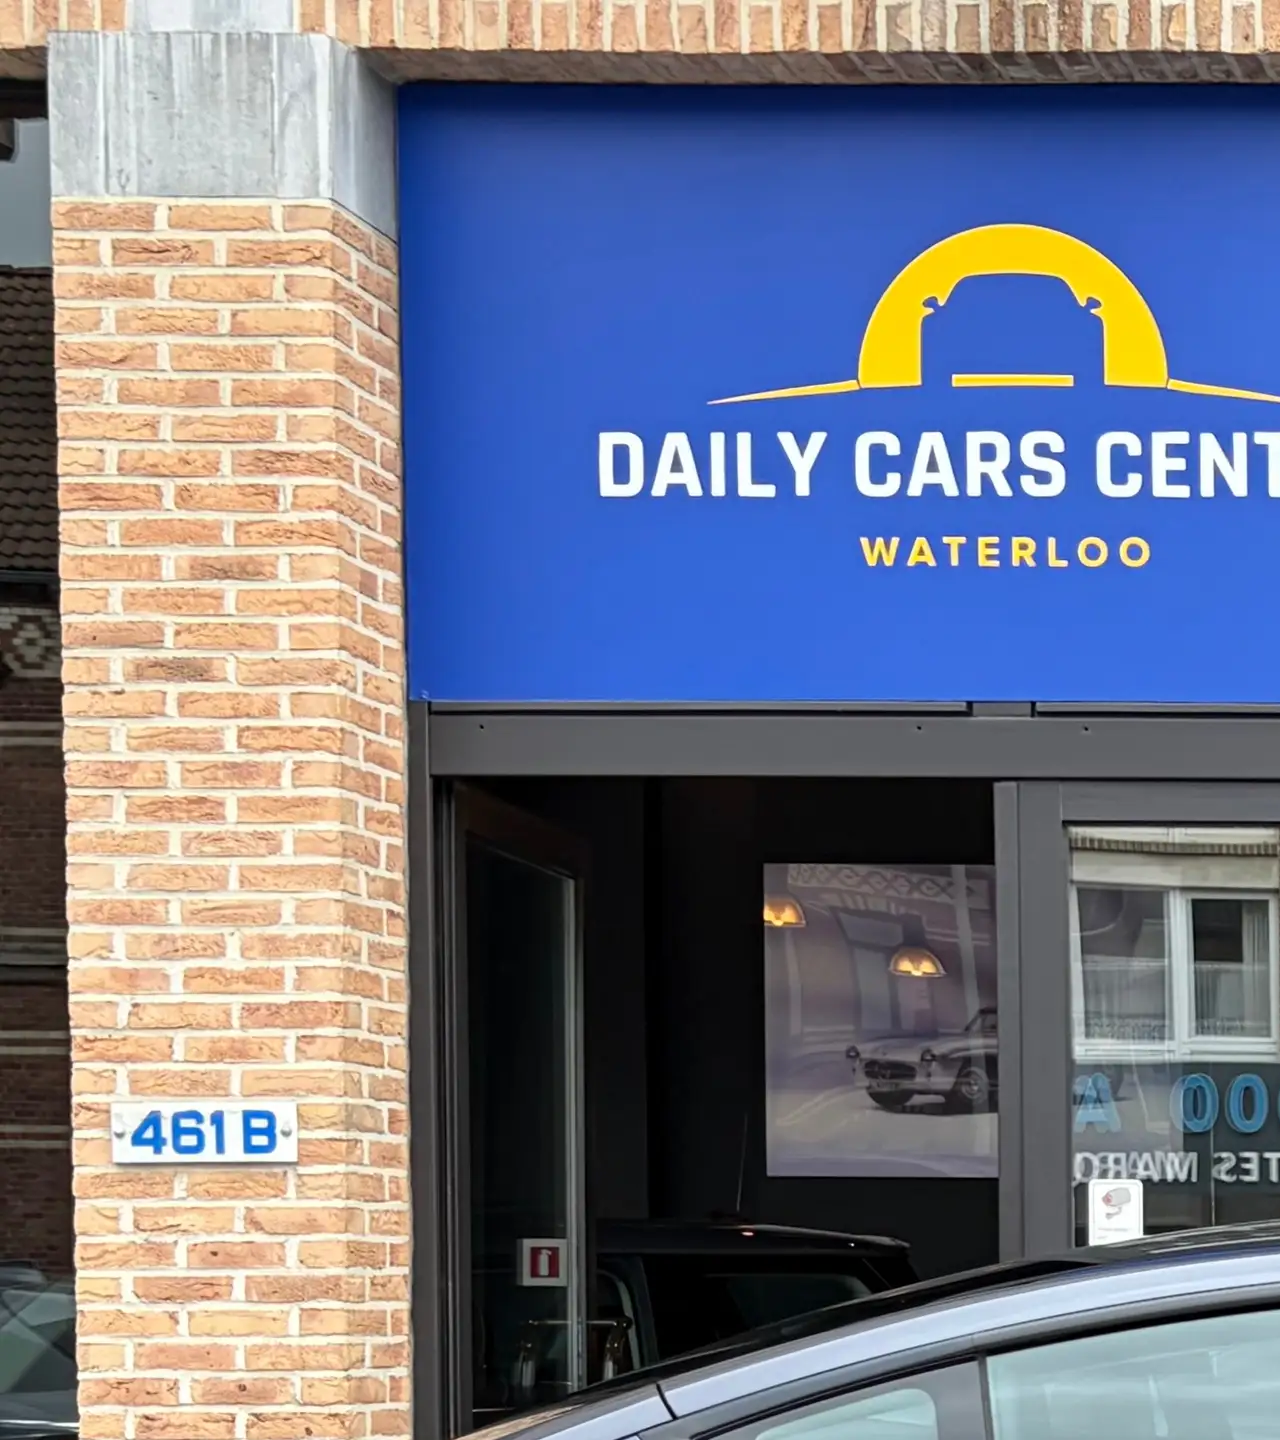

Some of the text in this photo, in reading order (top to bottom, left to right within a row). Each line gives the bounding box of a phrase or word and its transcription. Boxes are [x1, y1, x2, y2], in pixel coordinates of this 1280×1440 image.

[599, 431, 827, 498] DAILY
[854, 430, 1066, 498] CARS
[859, 536, 1151, 568] WATERLOO
[131, 1110, 277, 1154] 461 B
